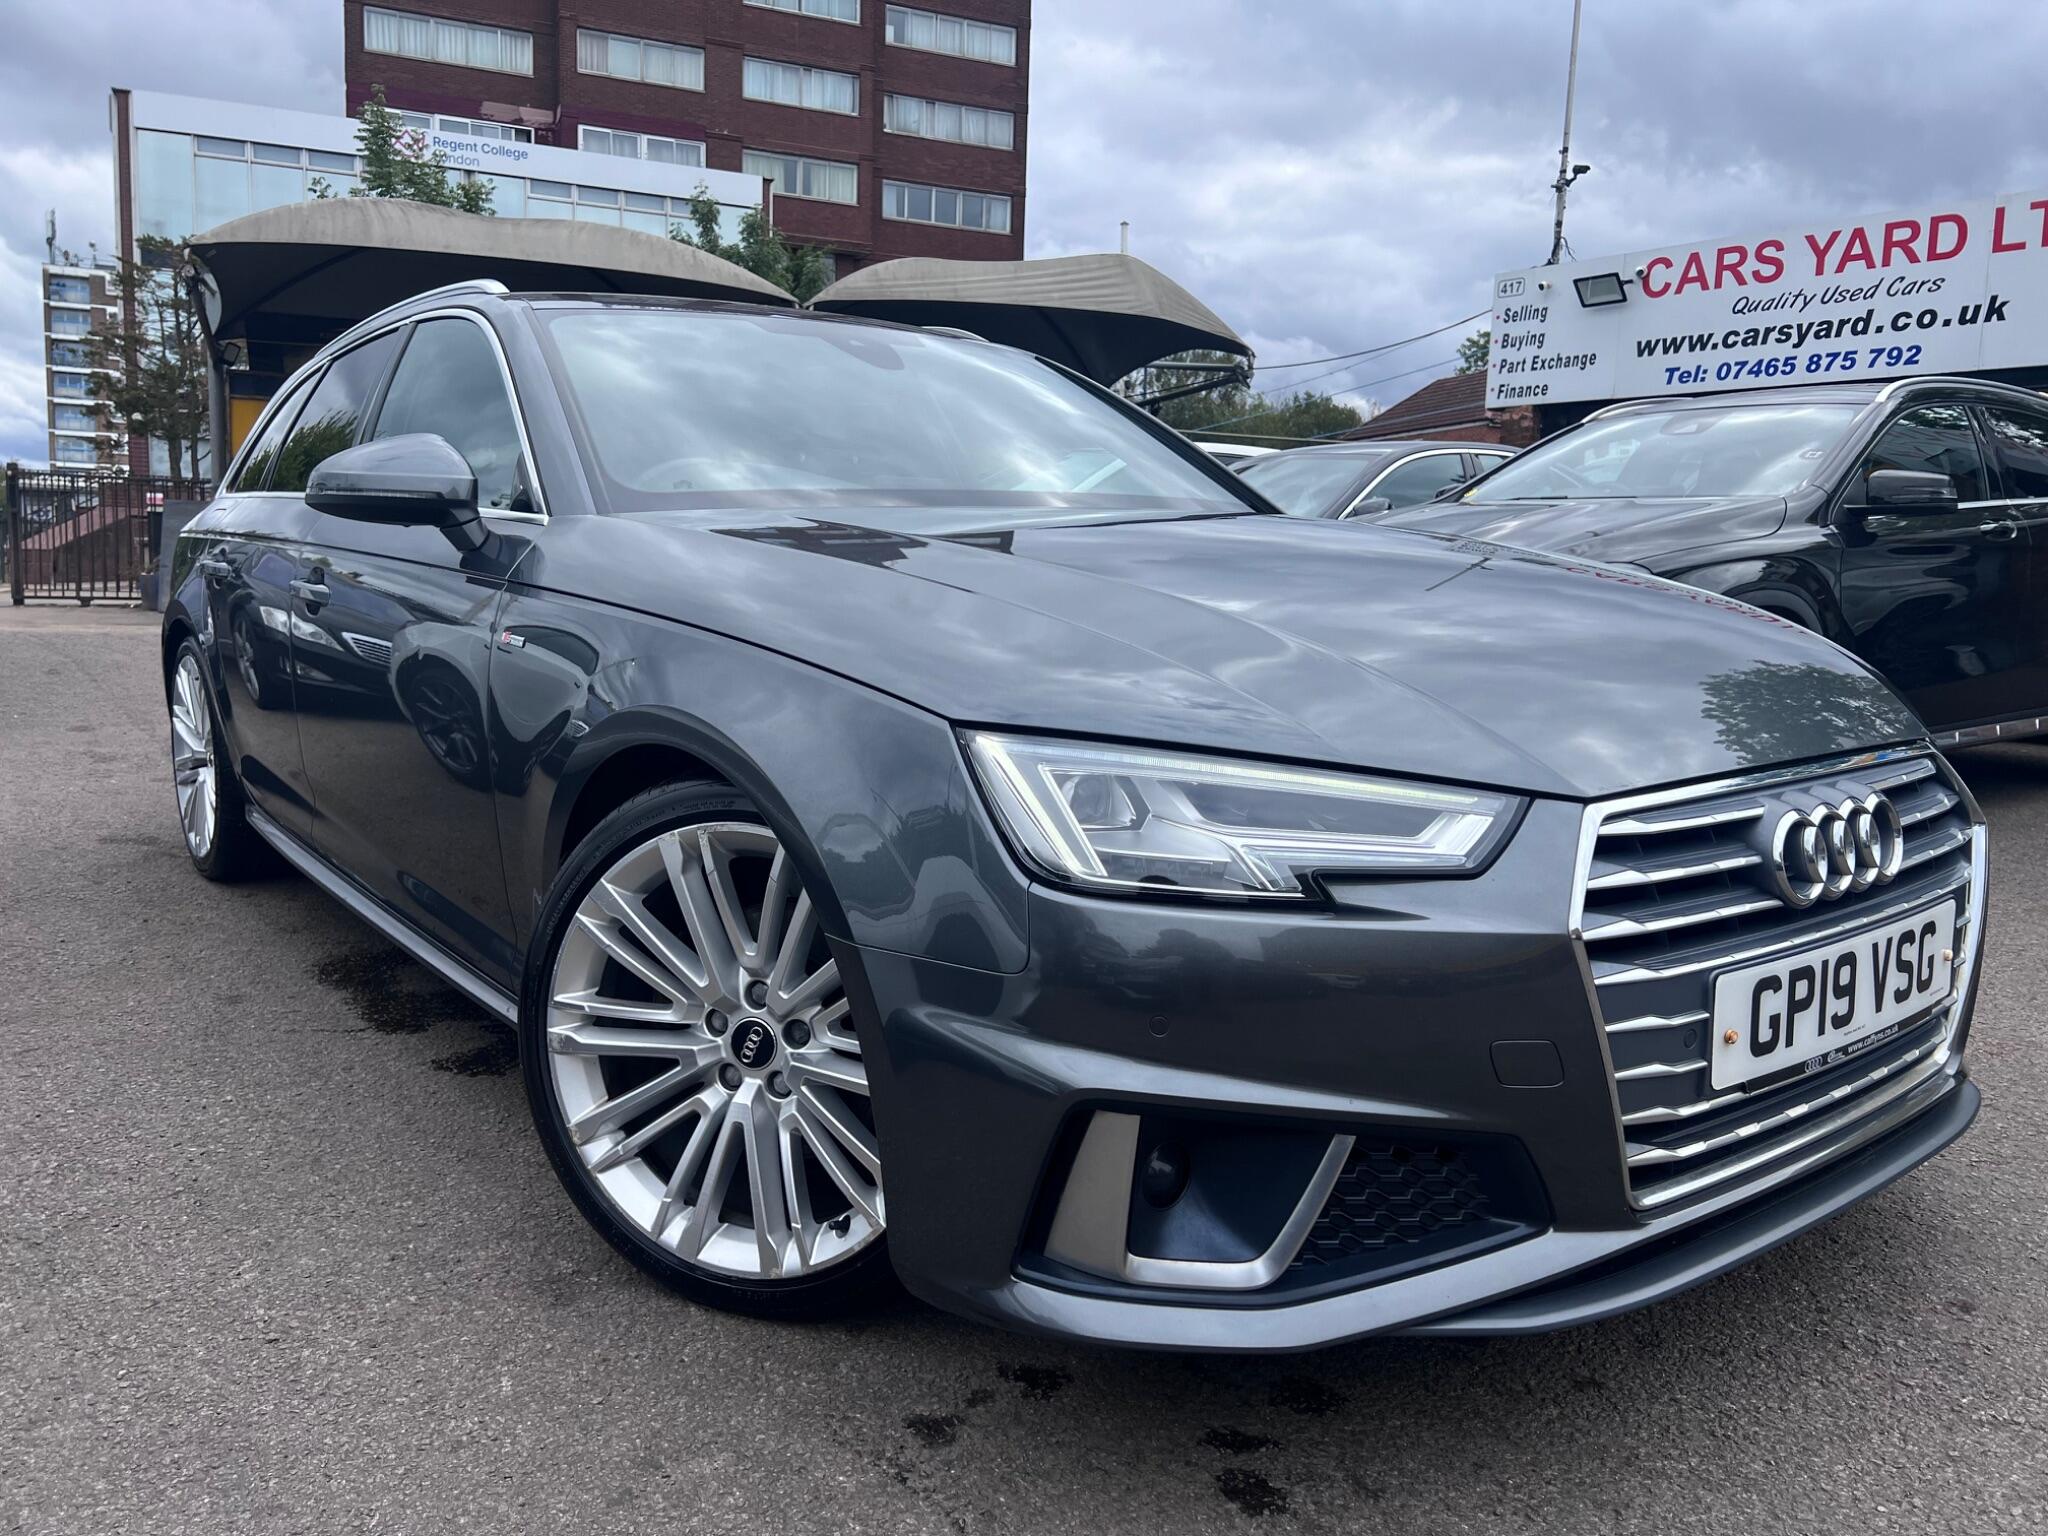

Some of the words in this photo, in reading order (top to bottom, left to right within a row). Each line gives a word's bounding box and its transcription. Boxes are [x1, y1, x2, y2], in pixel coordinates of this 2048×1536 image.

[433, 136, 478, 153] Regent
[480, 143, 529, 161] College
[1641, 239, 1785, 299] CARS
[1804, 213, 1969, 277] YARD
[1500, 281, 1522, 295] 417
[1731, 288, 1817, 316] Quality
[1819, 277, 1885, 305] Used
[1886, 276, 1946, 298] Cars
[1503, 304, 1548, 324] Selling
[1636, 294, 2011, 358] www.carsyard.co.uk
[1501, 330, 1546, 352] Buying
[1498, 357, 1527, 375] Part
[1530, 352, 1597, 371] Exchange
[1664, 364, 1709, 386] Tel:
[1716, 355, 1798, 381] 07465
[1805, 350, 1858, 374] 875
[1867, 345, 1923, 369] 792
[1496, 383, 1549, 401] Finance
[1749, 950, 1858, 1058] GP19
[1871, 919, 1938, 1015] VSG
